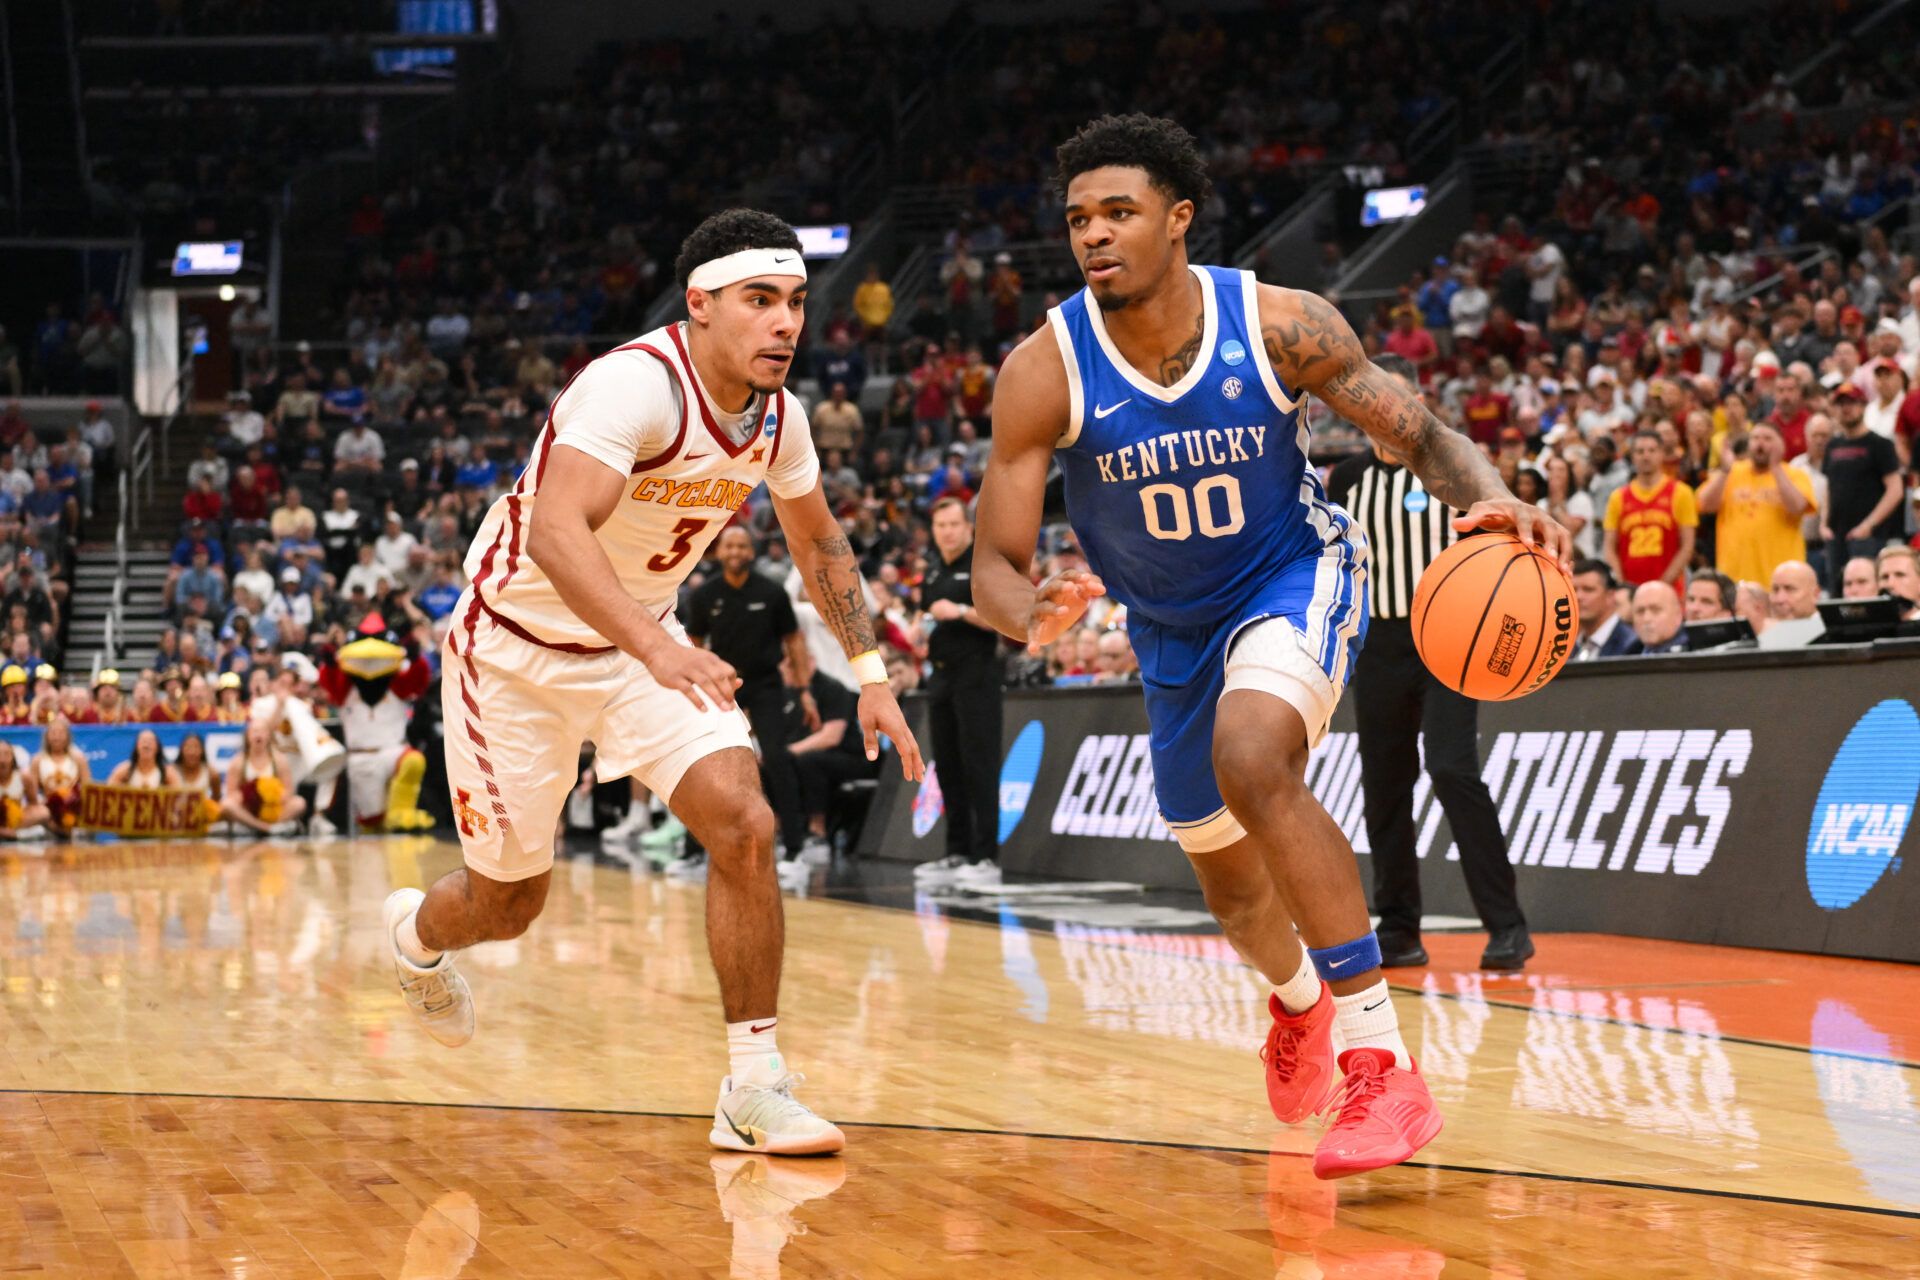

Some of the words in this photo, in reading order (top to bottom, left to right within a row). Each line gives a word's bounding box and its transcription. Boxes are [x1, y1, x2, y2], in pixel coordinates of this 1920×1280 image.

[1096, 426, 1266, 483] KENTUCKY
[1139, 473, 1245, 541] 00
[647, 518, 709, 572] 3
[1629, 525, 1663, 557] 22
[1488, 632, 1513, 673] MADNESS
[1503, 630, 1523, 664] MARCH
[84, 787, 202, 831] DEFENSE
[1811, 803, 1908, 857] NCAA
